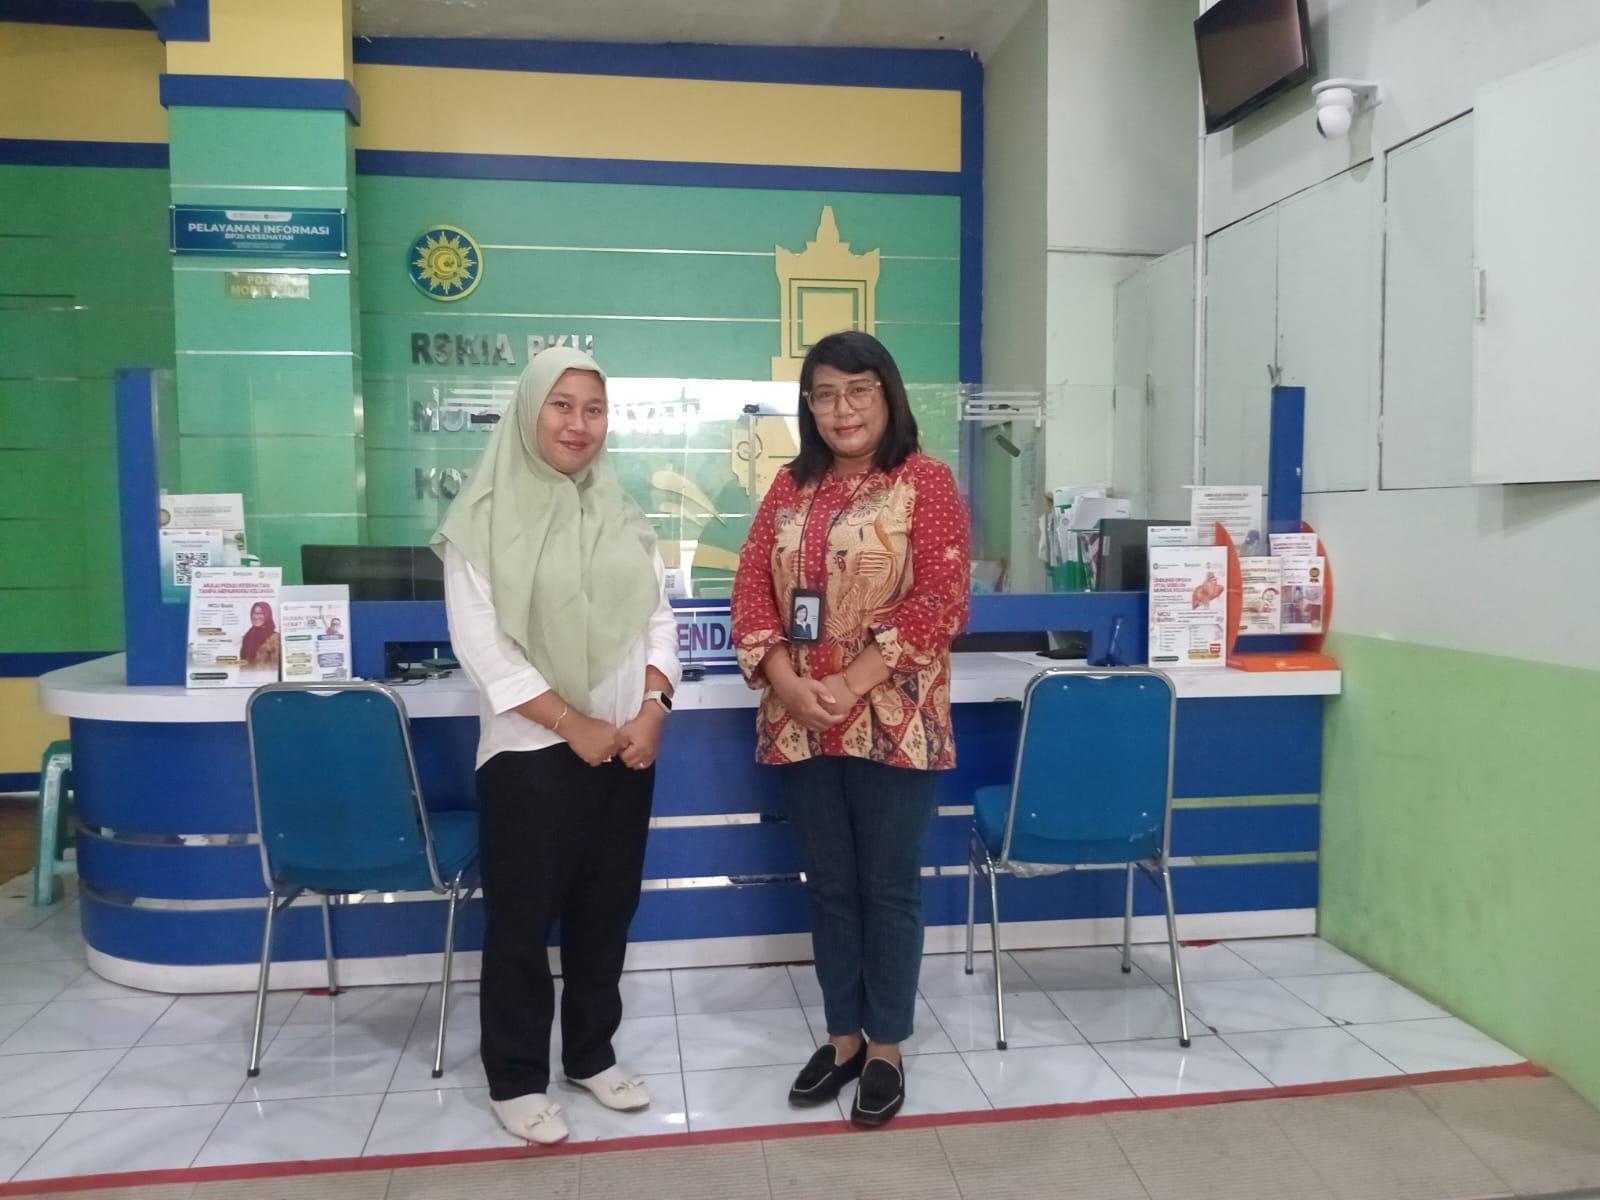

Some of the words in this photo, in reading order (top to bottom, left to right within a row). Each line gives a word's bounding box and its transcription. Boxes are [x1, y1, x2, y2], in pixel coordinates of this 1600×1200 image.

[188, 223, 260, 233] PELAYANAN
[264, 225, 330, 235] INFORMASI
[411, 332, 517, 366] RSKIA
[676, 622, 734, 651] END
